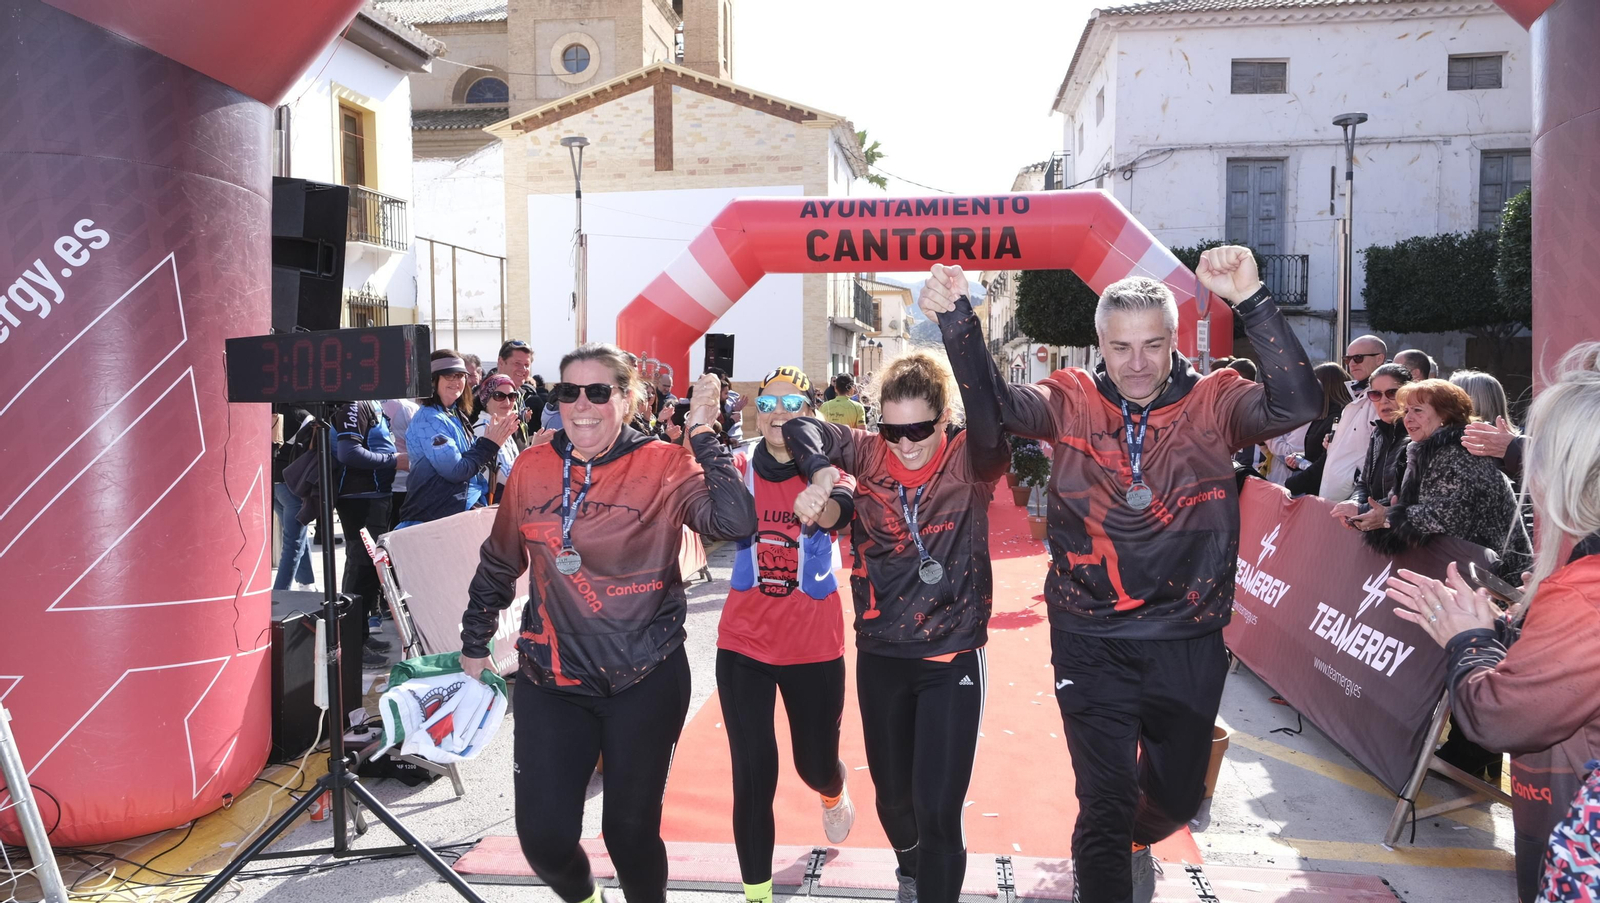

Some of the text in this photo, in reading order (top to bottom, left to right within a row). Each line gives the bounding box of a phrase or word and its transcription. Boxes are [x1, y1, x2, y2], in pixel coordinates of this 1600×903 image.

[799, 196, 1030, 219] AYUNTAMIENTO
[806, 226, 1022, 262] CANTORIA
[0, 218, 110, 344] rgy.es
[908, 520, 955, 541] Cntoria
[606, 579, 663, 597] Cantoria
[1309, 602, 1415, 677] TEAMERGY
[1313, 657, 1362, 698] www.teamergy.es
